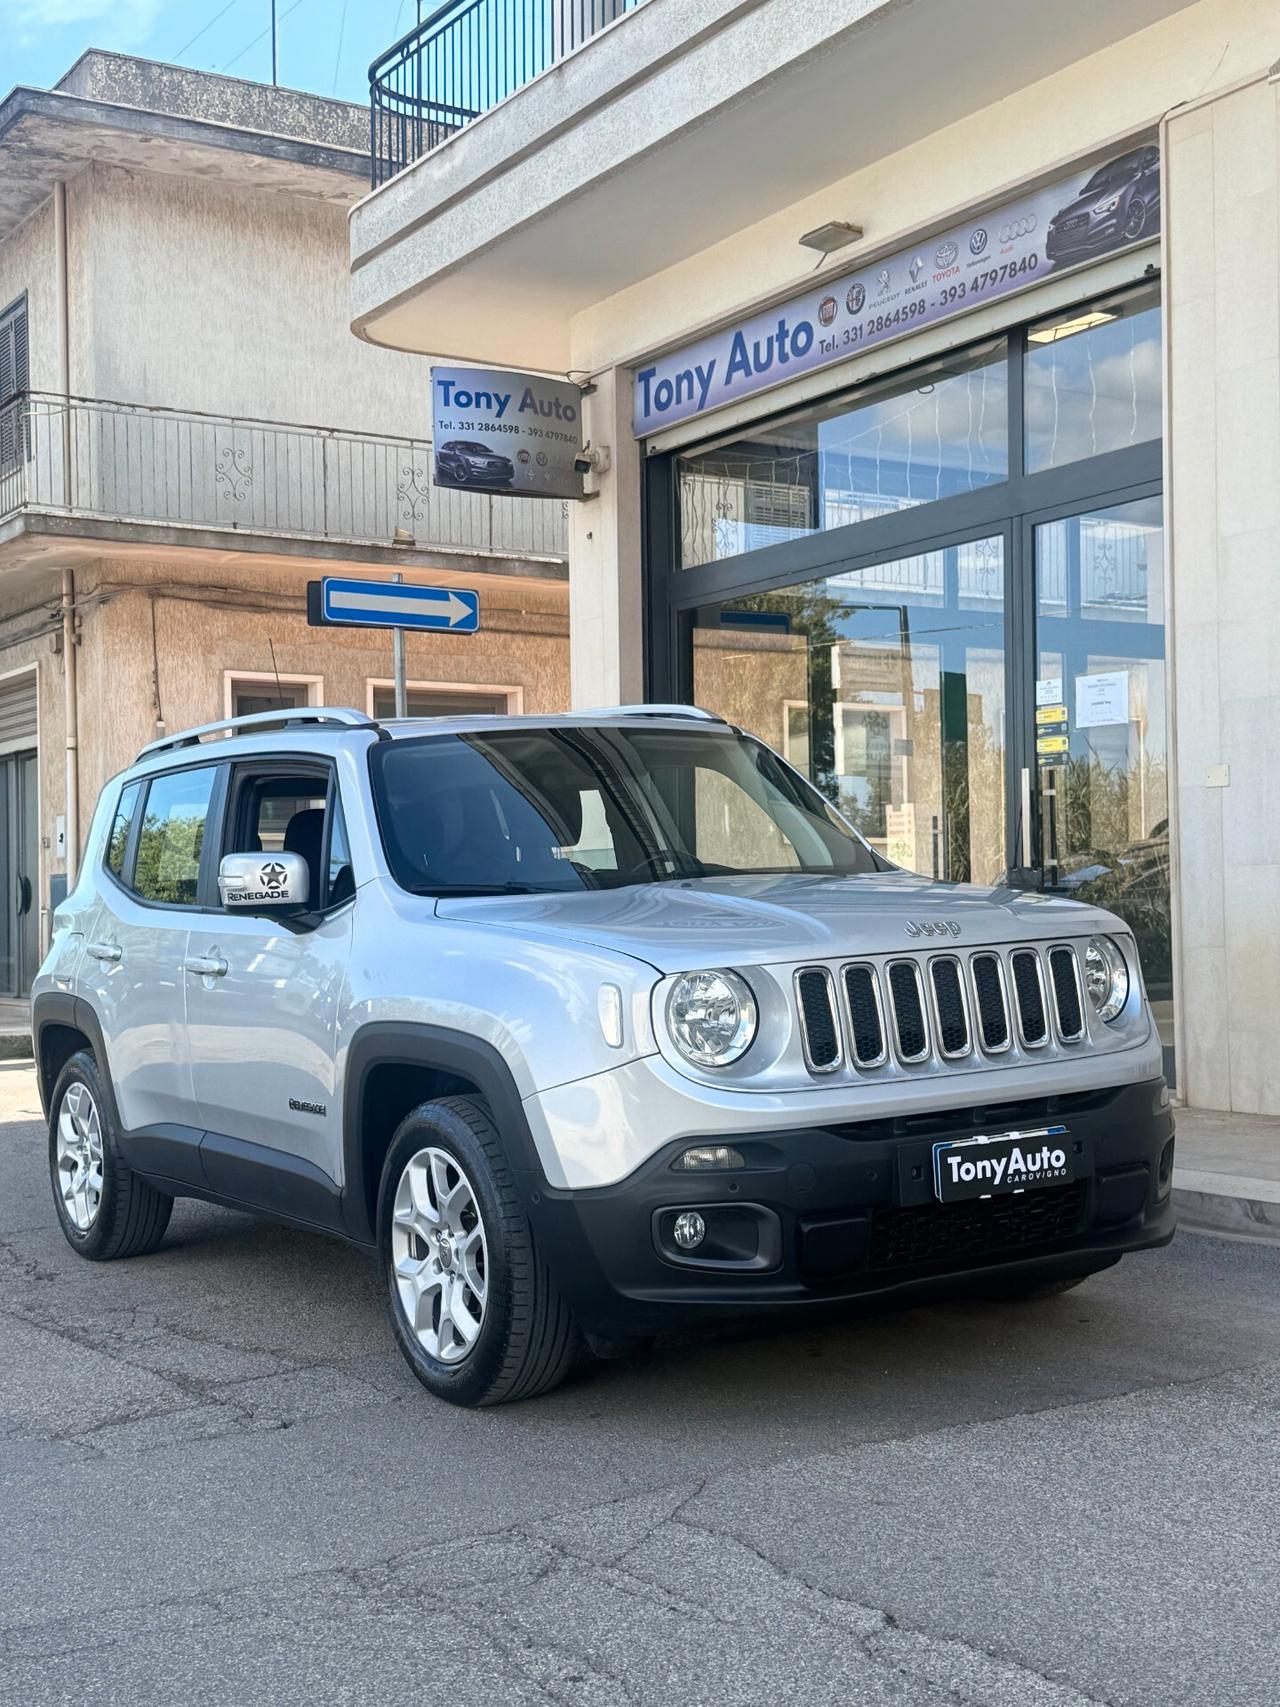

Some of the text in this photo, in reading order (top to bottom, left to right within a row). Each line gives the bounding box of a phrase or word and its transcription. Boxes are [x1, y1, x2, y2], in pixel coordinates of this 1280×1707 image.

[932, 265, 960, 283] TOYOTA
[904, 280, 928, 296] RENAULT
[819, 334, 839, 355] Tel.
[843, 323, 863, 345] 331
[867, 298, 926, 337] 2864598
[939, 282, 966, 307] 393
[970, 252, 1038, 293] 4797840
[868, 292, 901, 310] PEUGEOT
[637, 318, 814, 417] Tony Auto
[437, 380, 577, 423] Tony Auto
[438, 420, 456, 431] Tel.
[458, 421, 475, 431] 331
[478, 422, 520, 434] 2864598
[528, 427, 544, 438] 393
[227, 890, 290, 902] RENEGADE
[903, 920, 961, 939] Jeep
[1007, 1168, 1068, 1184] CAROVIGNO
